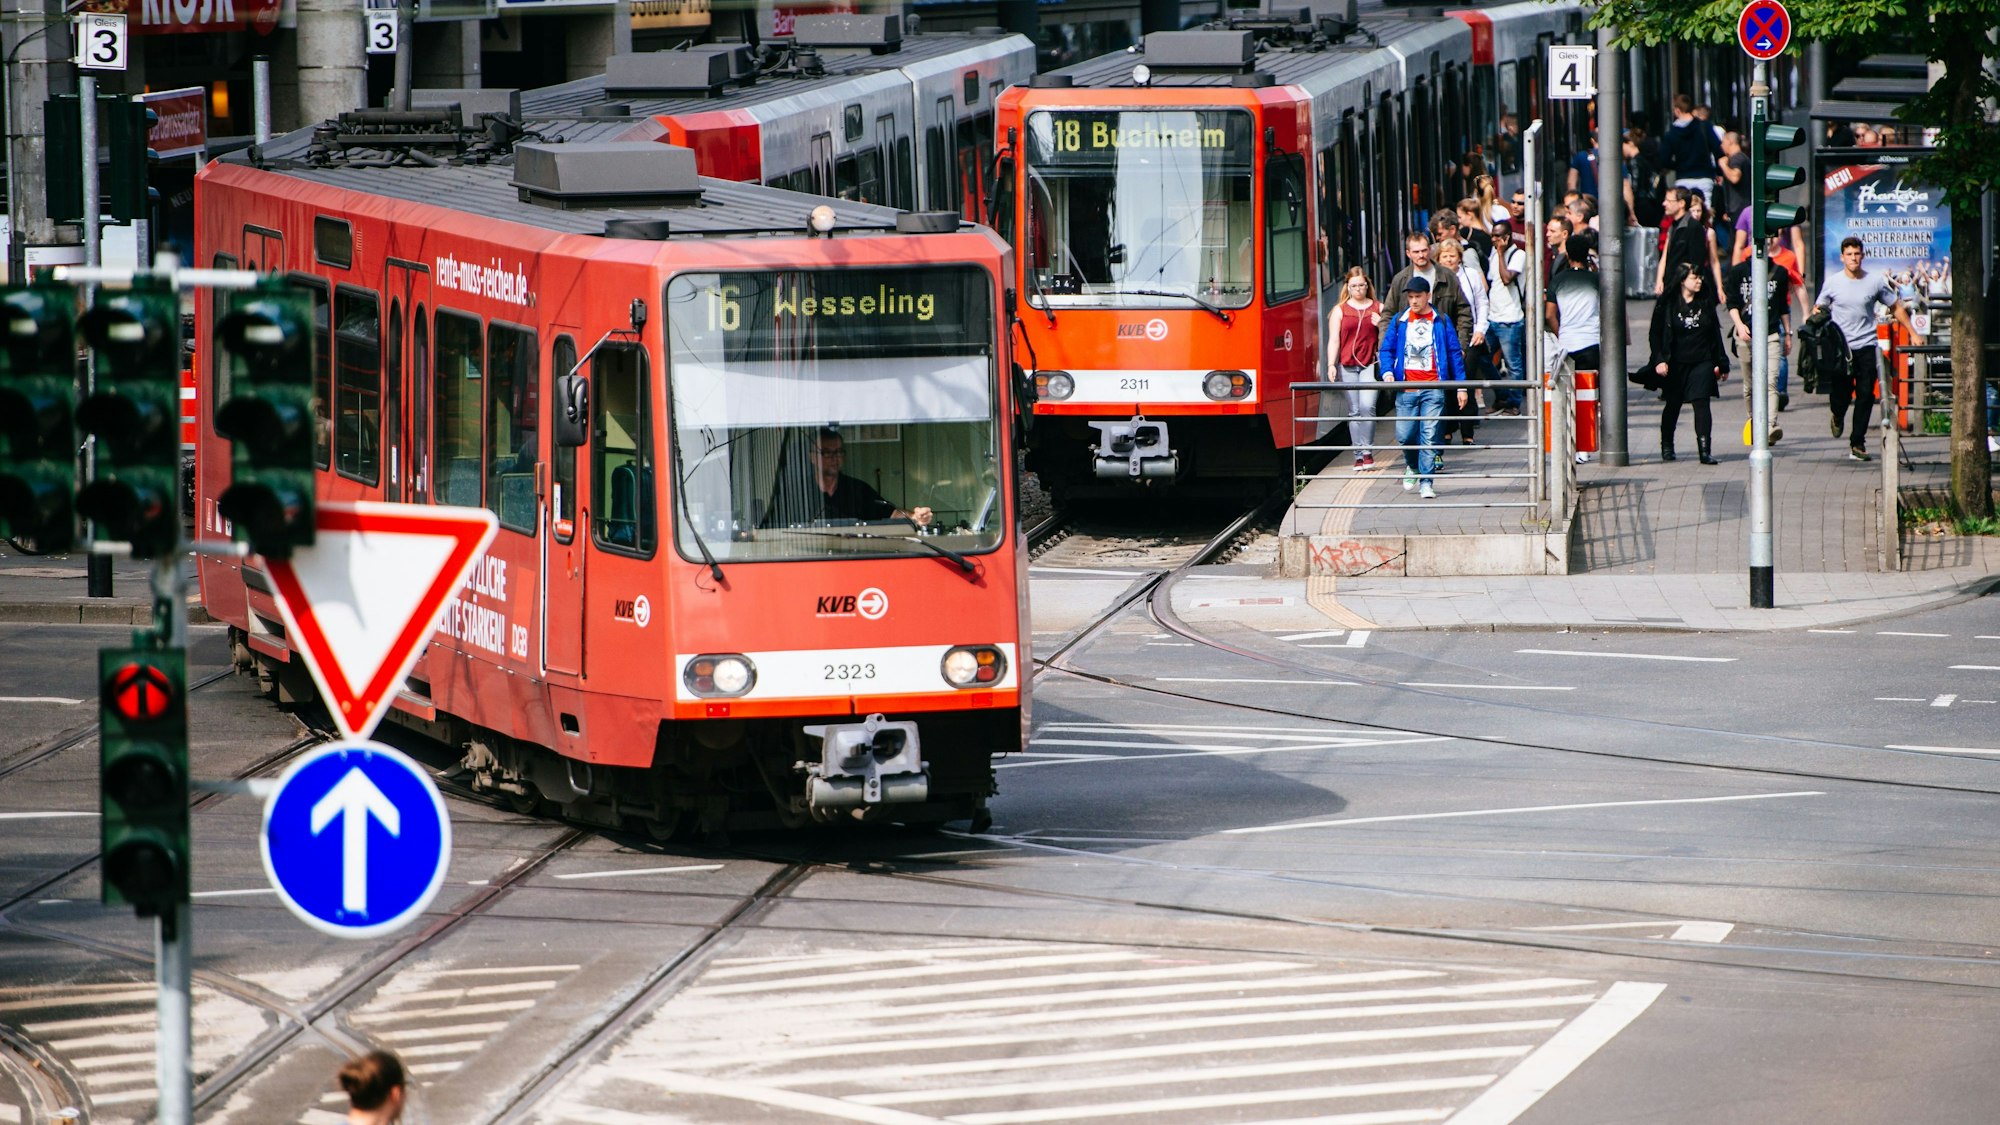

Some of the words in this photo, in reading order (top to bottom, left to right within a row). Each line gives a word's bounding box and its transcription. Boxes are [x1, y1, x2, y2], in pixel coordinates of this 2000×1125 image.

[94, 18, 117, 27] Gleis
[375, 22, 393, 49] 3
[93, 29, 118, 63] 3
[1558, 51, 1579, 60] Gleis
[1560, 63, 1580, 91] 4
[1055, 120, 1081, 151] 18
[1092, 121, 1225, 148] Buchheim
[1825, 167, 1853, 191] NEU!
[1858, 204, 1929, 213] LAND
[1861, 231, 1933, 243] ACHTERBAHNEN
[1865, 246, 1929, 258] WELTREKORDE
[436, 252, 528, 306] rente-muss-reichen.de
[705, 285, 741, 332] 16
[774, 284, 935, 320] Wesseling
[1117, 323, 1146, 337] KVB
[1120, 378, 1149, 390] 2311
[615, 599, 635, 618] KVB
[816, 595, 857, 613] KVB
[462, 593, 506, 656] STÄRKEN!
[511, 623, 528, 658] DGB
[823, 663, 877, 681] 2323
